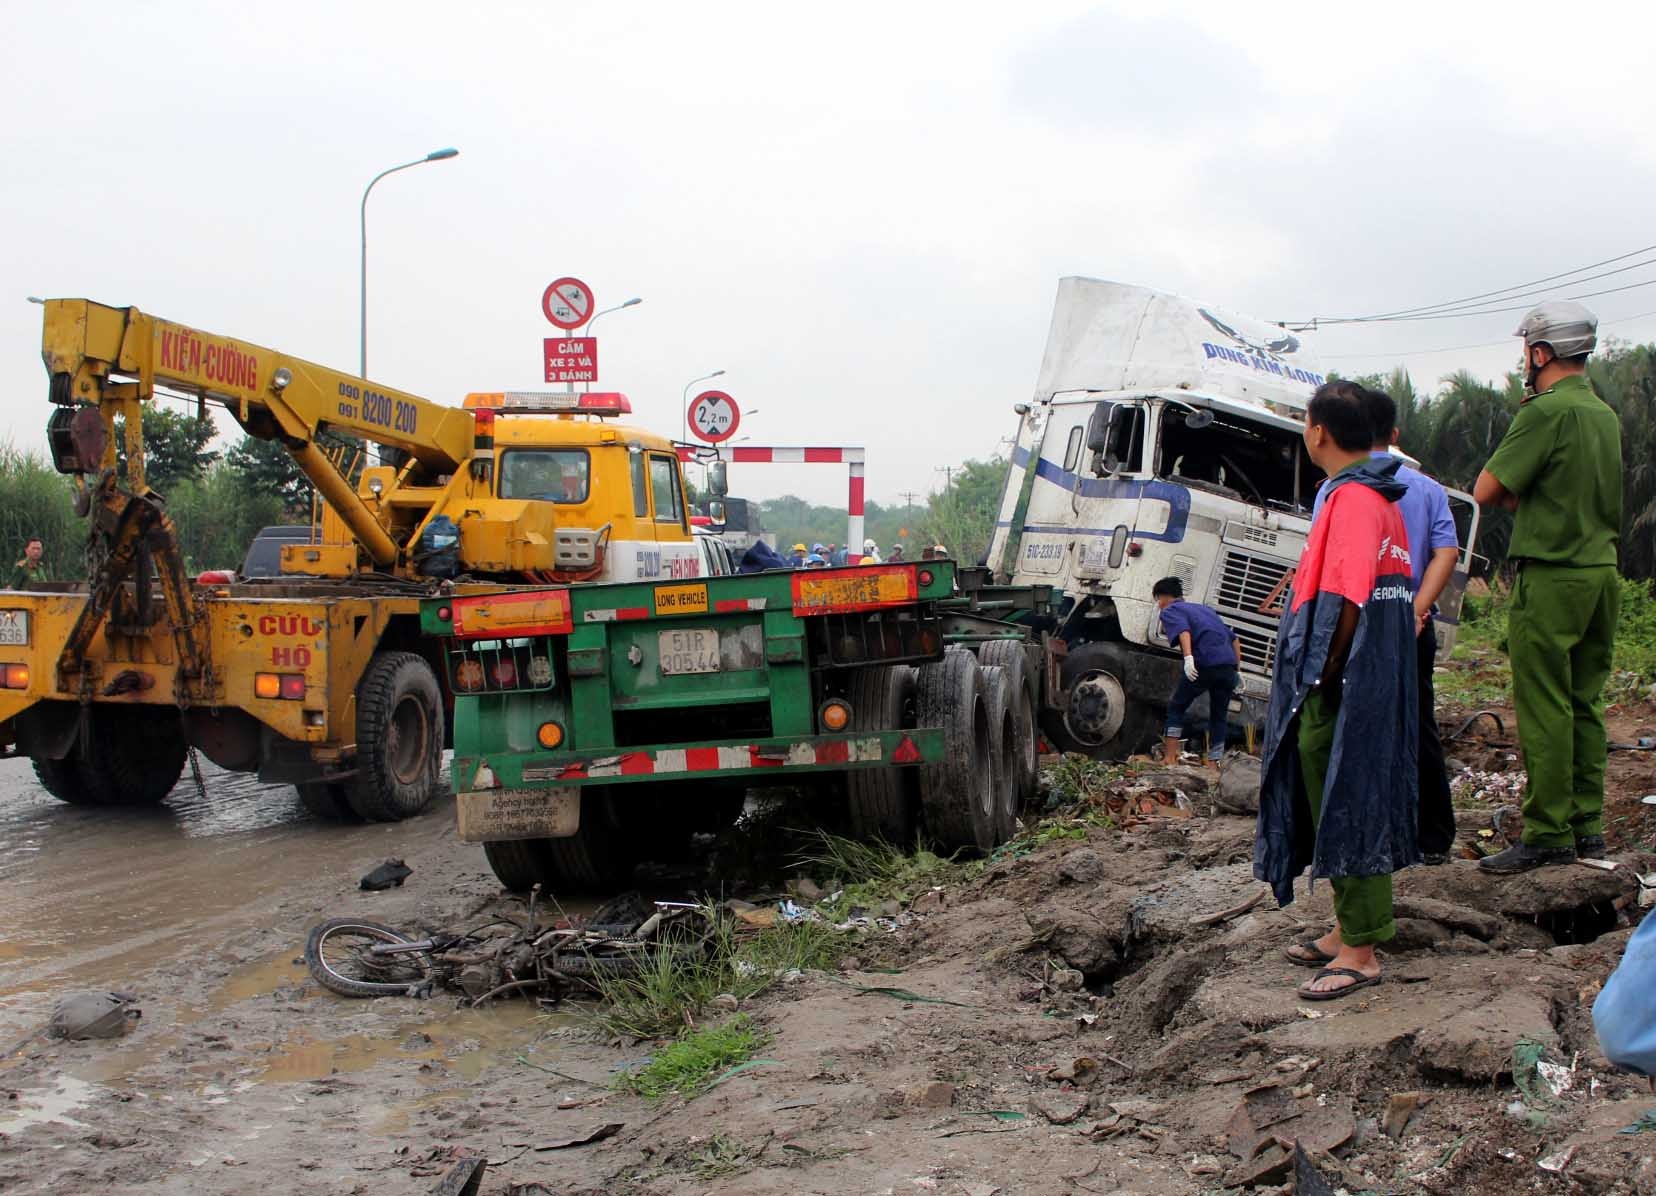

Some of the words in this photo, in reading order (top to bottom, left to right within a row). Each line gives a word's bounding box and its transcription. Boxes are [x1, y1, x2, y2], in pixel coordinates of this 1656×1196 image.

[558, 339, 584, 354] CẤM
[550, 358, 565, 367] XE
[568, 358, 576, 367] 2
[1250, 355, 1283, 376] KIM
[549, 371, 556, 380] 3
[559, 369, 592, 380] BÁNH
[339, 382, 359, 400] 090
[363, 389, 392, 427] 8200
[395, 400, 417, 434] 200
[339, 402, 358, 419] 091
[657, 594, 675, 607] LONG
[678, 592, 706, 605] VEHICLE
[672, 632, 705, 652] 51R
[272, 644, 312, 672] HỘ
